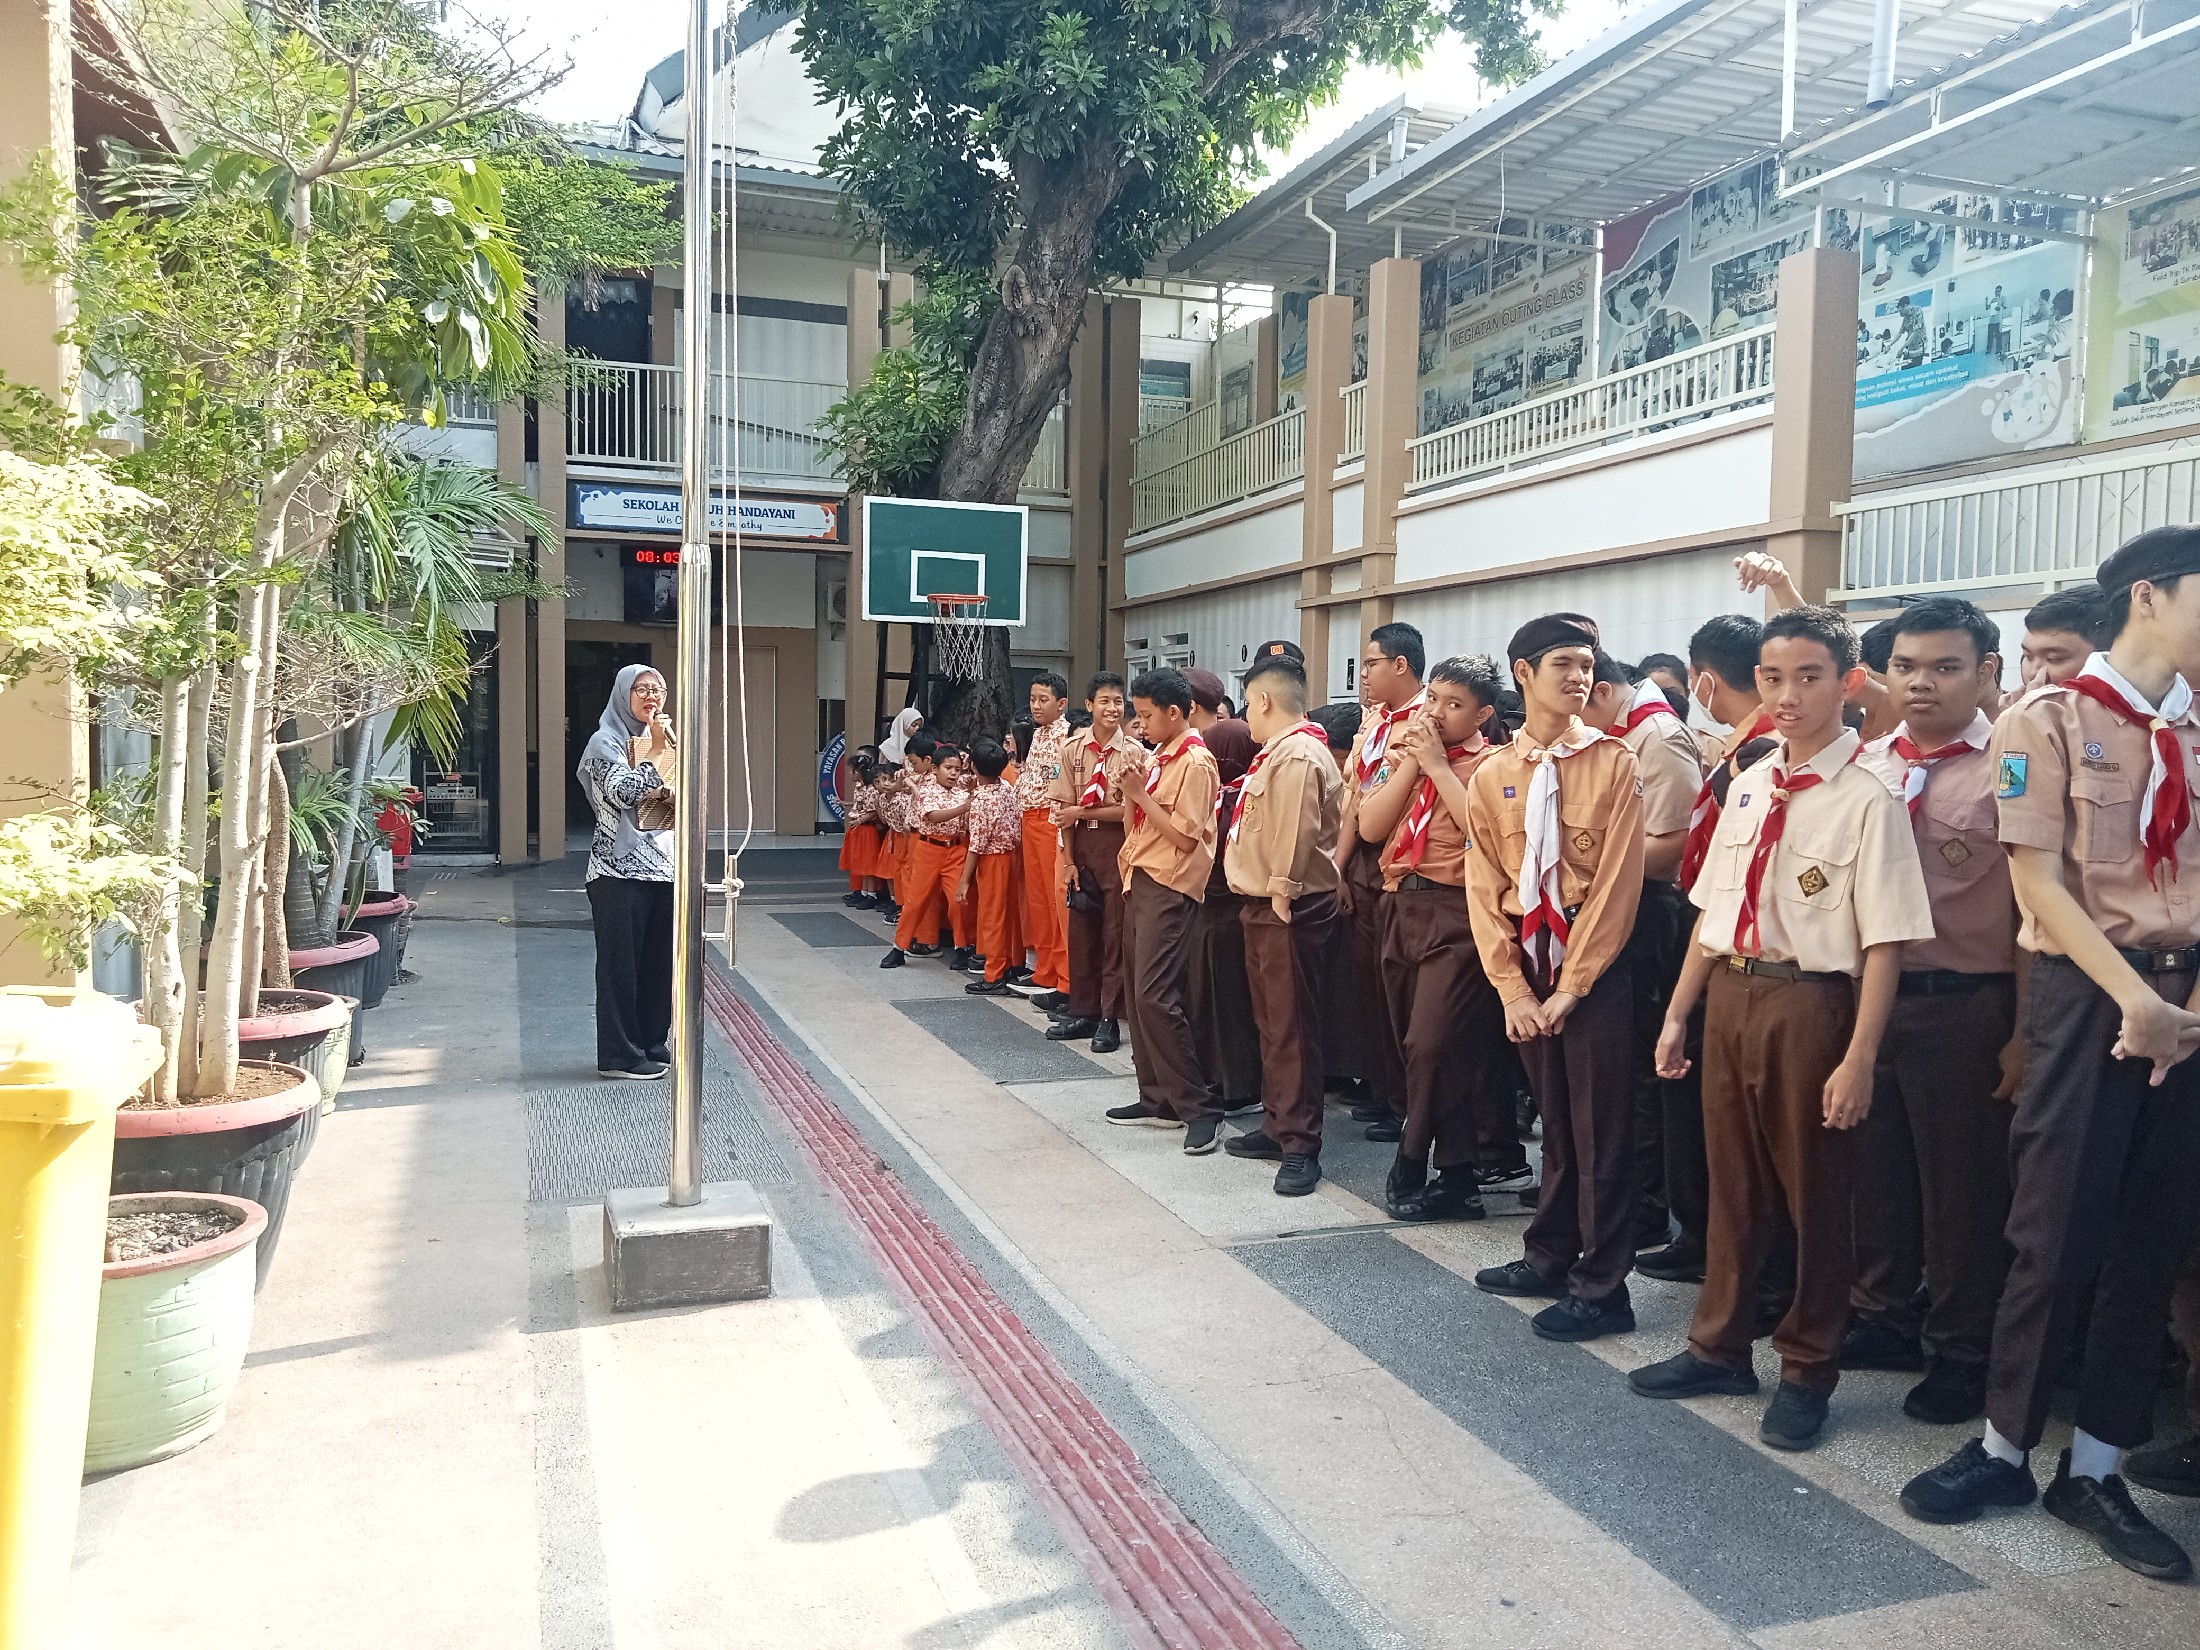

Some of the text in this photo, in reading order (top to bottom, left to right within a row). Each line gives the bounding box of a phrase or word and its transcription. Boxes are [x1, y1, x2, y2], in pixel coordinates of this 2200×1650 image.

[1450, 313, 1499, 347] KEGIATAN
[1501, 297, 1542, 327] OUTING
[1545, 280, 1586, 309] CLASS
[622, 498, 679, 513] SEKOLAH
[727, 504, 796, 520] HANDAYANI
[656, 514, 673, 525] We
[636, 550, 681, 564] 08:03
[823, 744, 843, 774] YAYASAN
